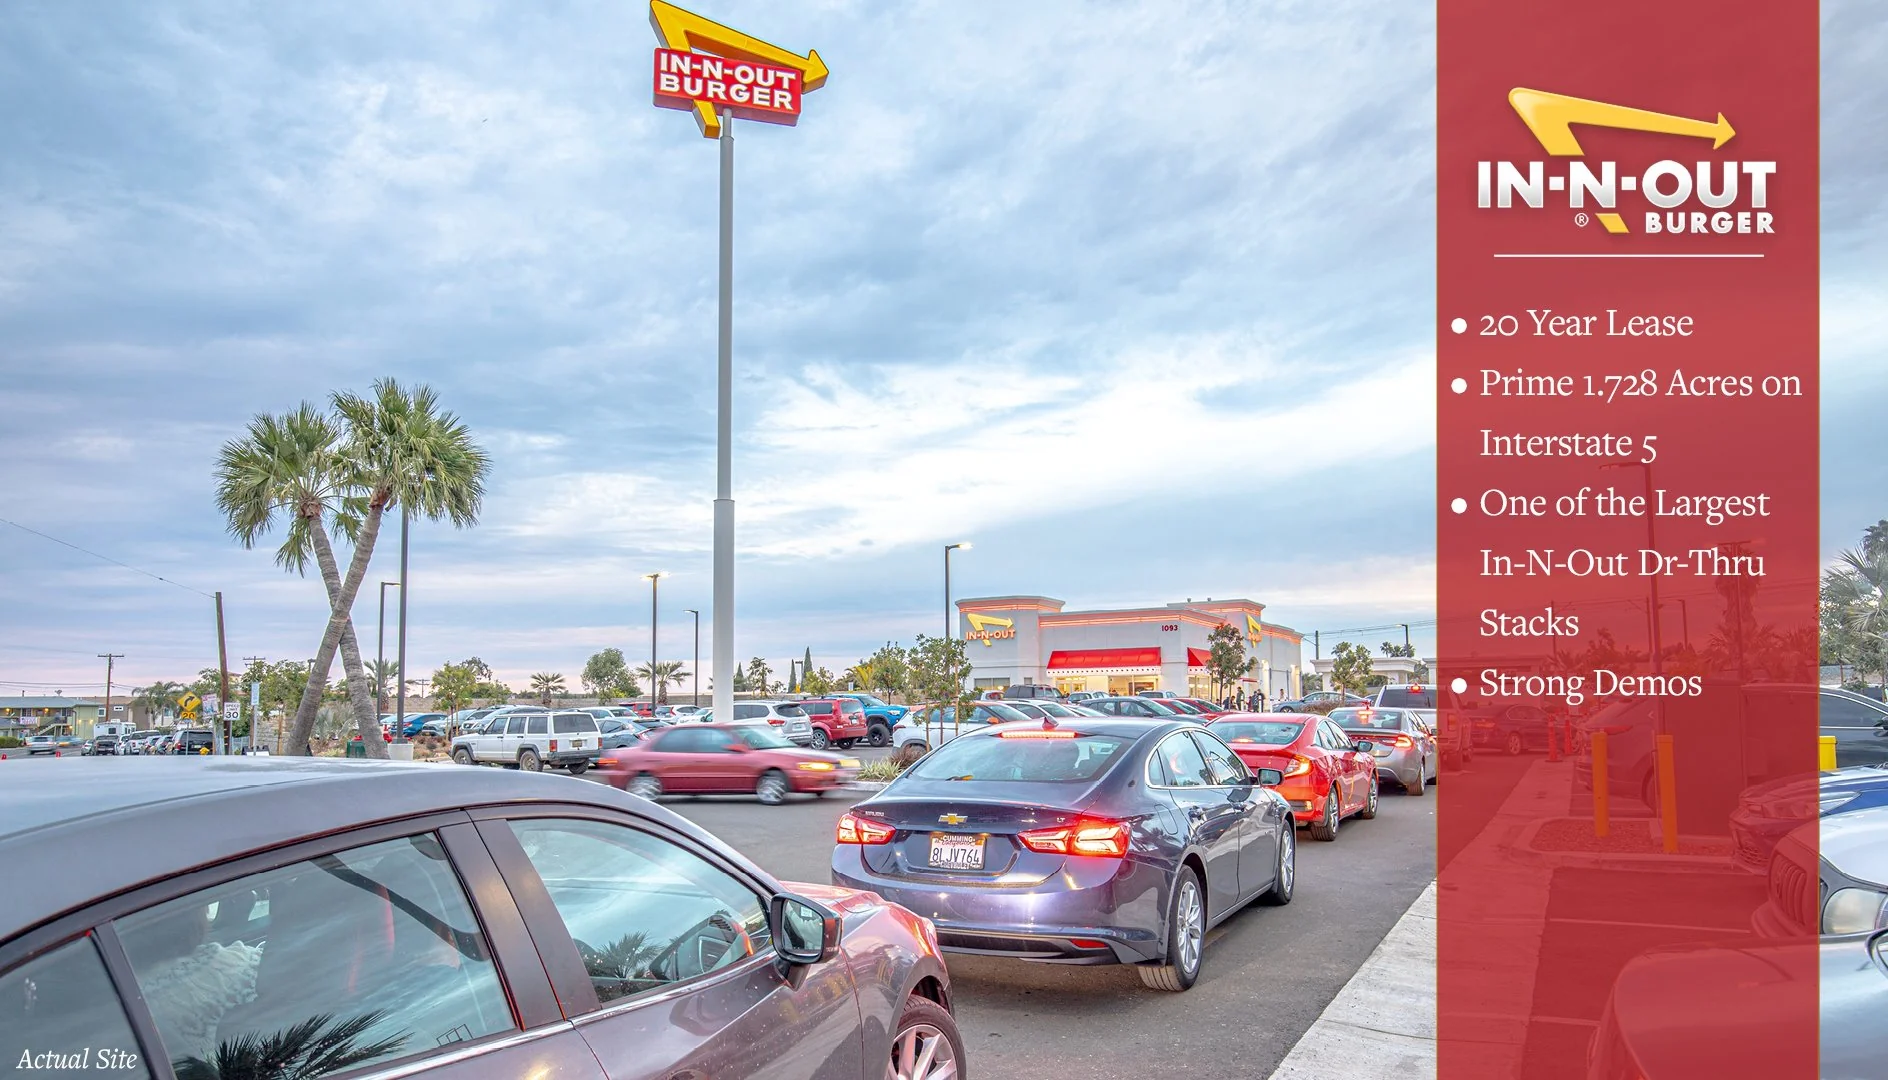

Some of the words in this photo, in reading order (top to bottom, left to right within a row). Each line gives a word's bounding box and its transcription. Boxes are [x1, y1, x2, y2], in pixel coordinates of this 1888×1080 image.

[660, 53, 796, 89] IN-N-OUT
[659, 73, 794, 110] BURGER
[1161, 624, 1179, 632] 1093
[965, 630, 1016, 640] IN-N-OUT
[225, 711, 239, 719] 30
[932, 847, 980, 863] 8LJV764
